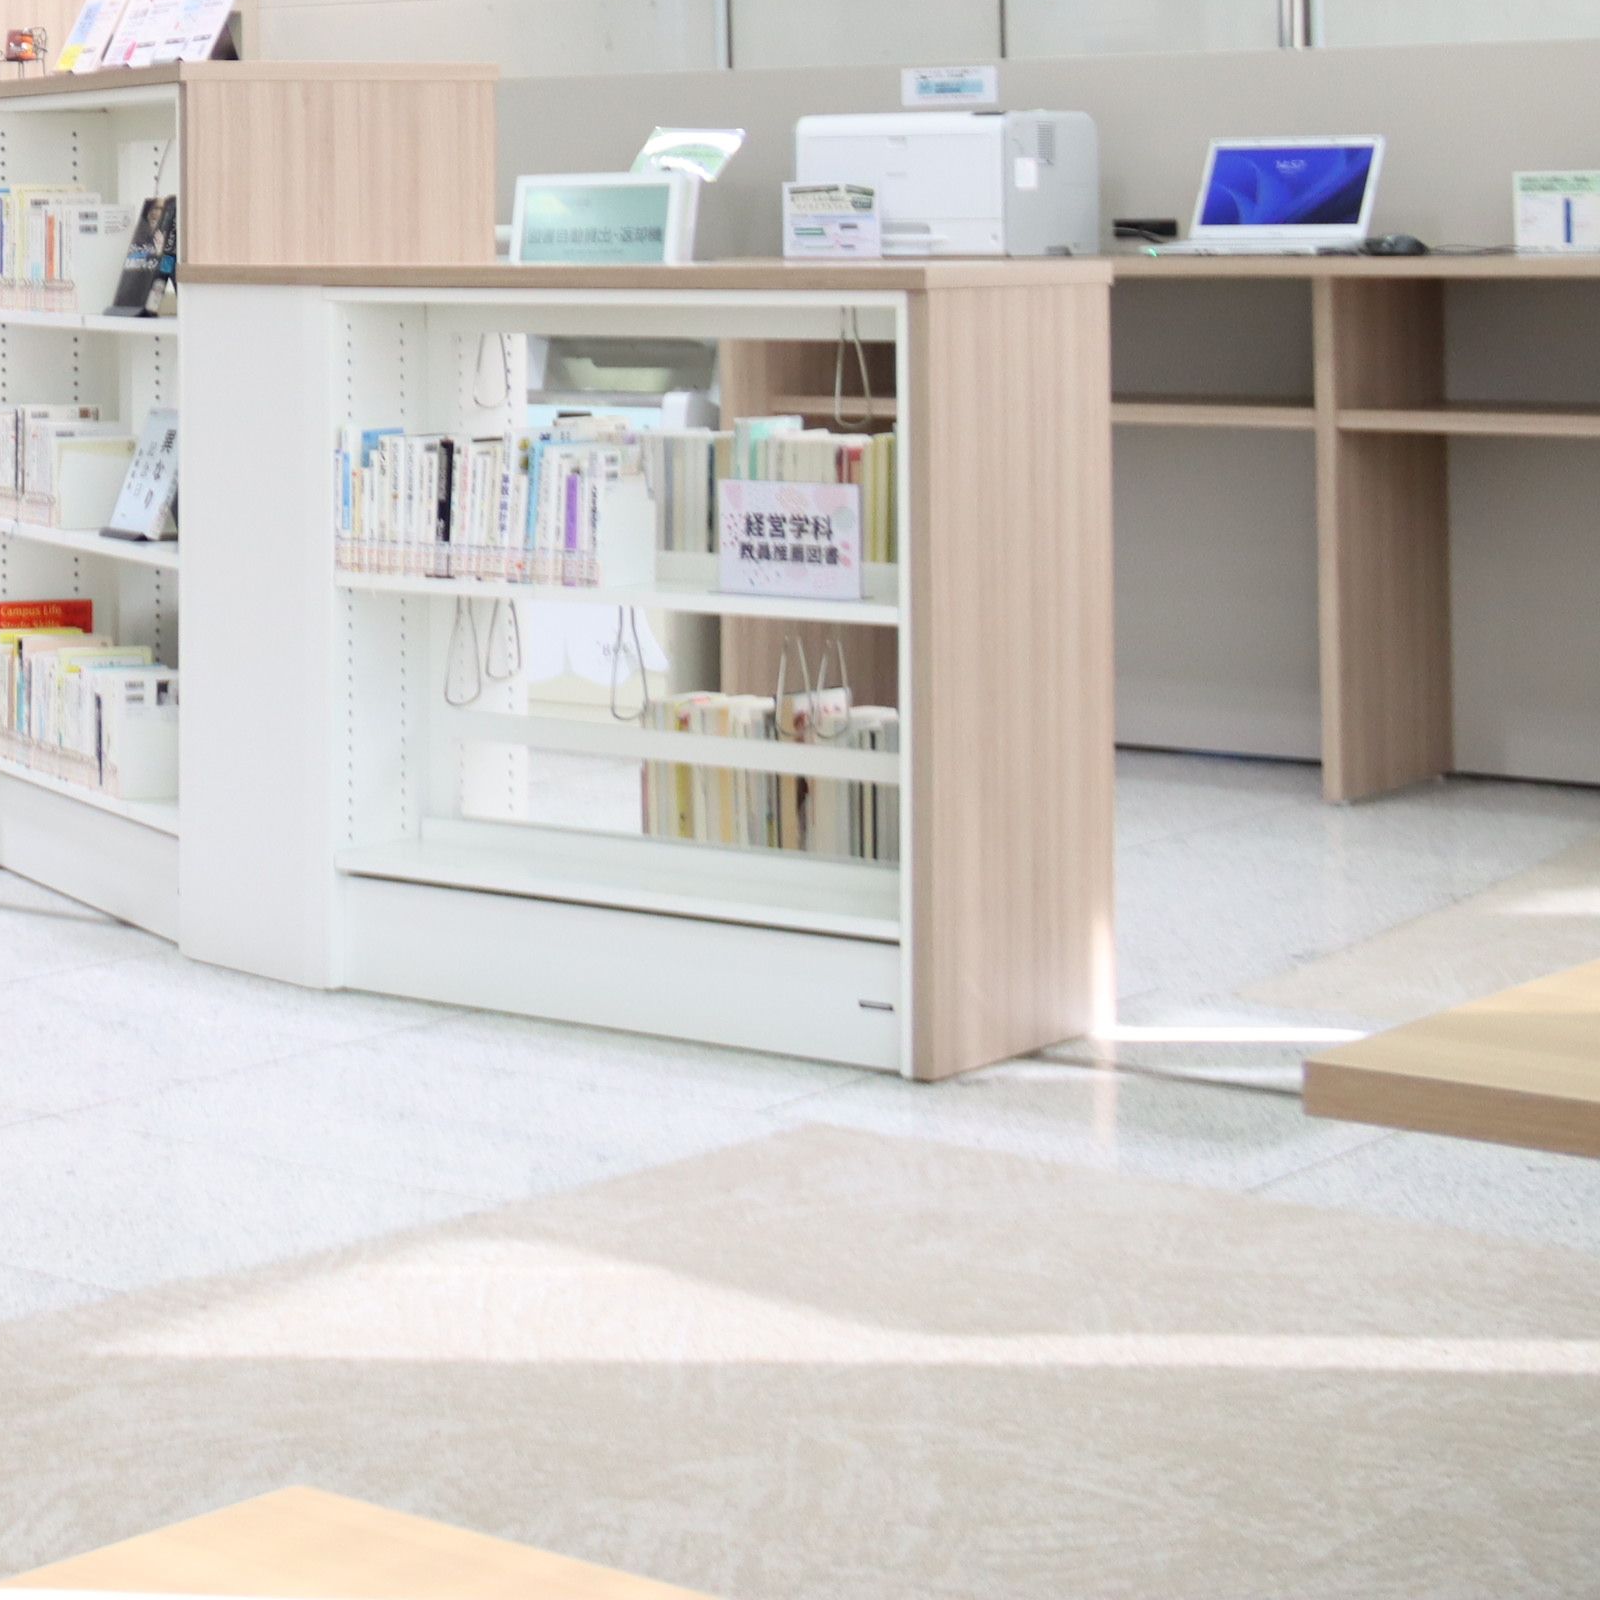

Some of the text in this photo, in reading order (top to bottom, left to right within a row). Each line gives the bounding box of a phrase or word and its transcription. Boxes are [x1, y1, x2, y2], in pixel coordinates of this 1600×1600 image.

[745, 512, 833, 541] 経営学科
[0, 603, 62, 617] Campus Life
